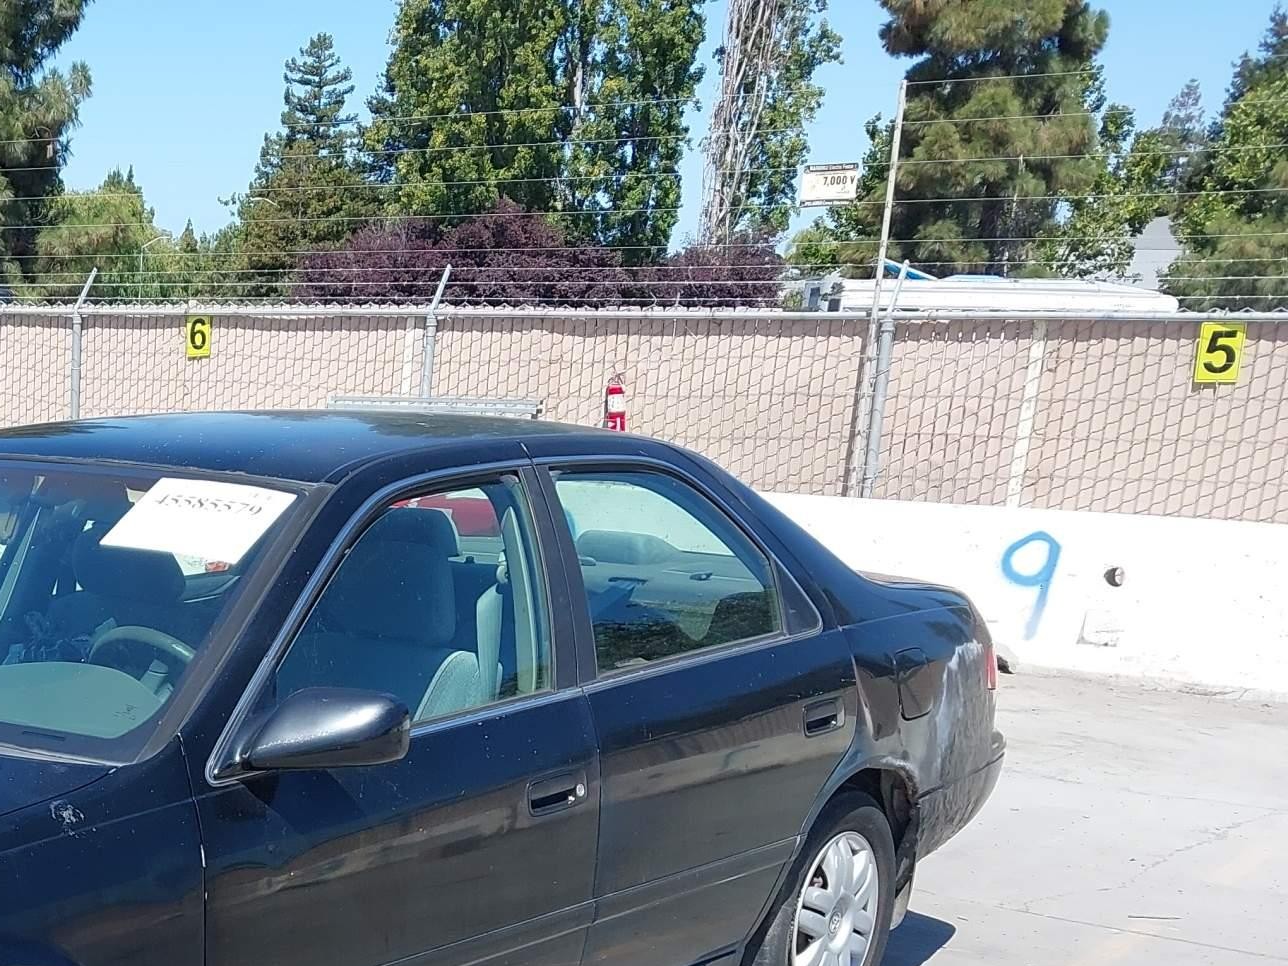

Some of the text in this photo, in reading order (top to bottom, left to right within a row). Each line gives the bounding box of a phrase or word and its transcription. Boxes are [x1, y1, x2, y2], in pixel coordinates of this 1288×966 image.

[823, 174, 856, 187] 7,000 V
[190, 317, 207, 350] 6
[1203, 329, 1238, 374] 5
[1001, 530, 1062, 640] 9
